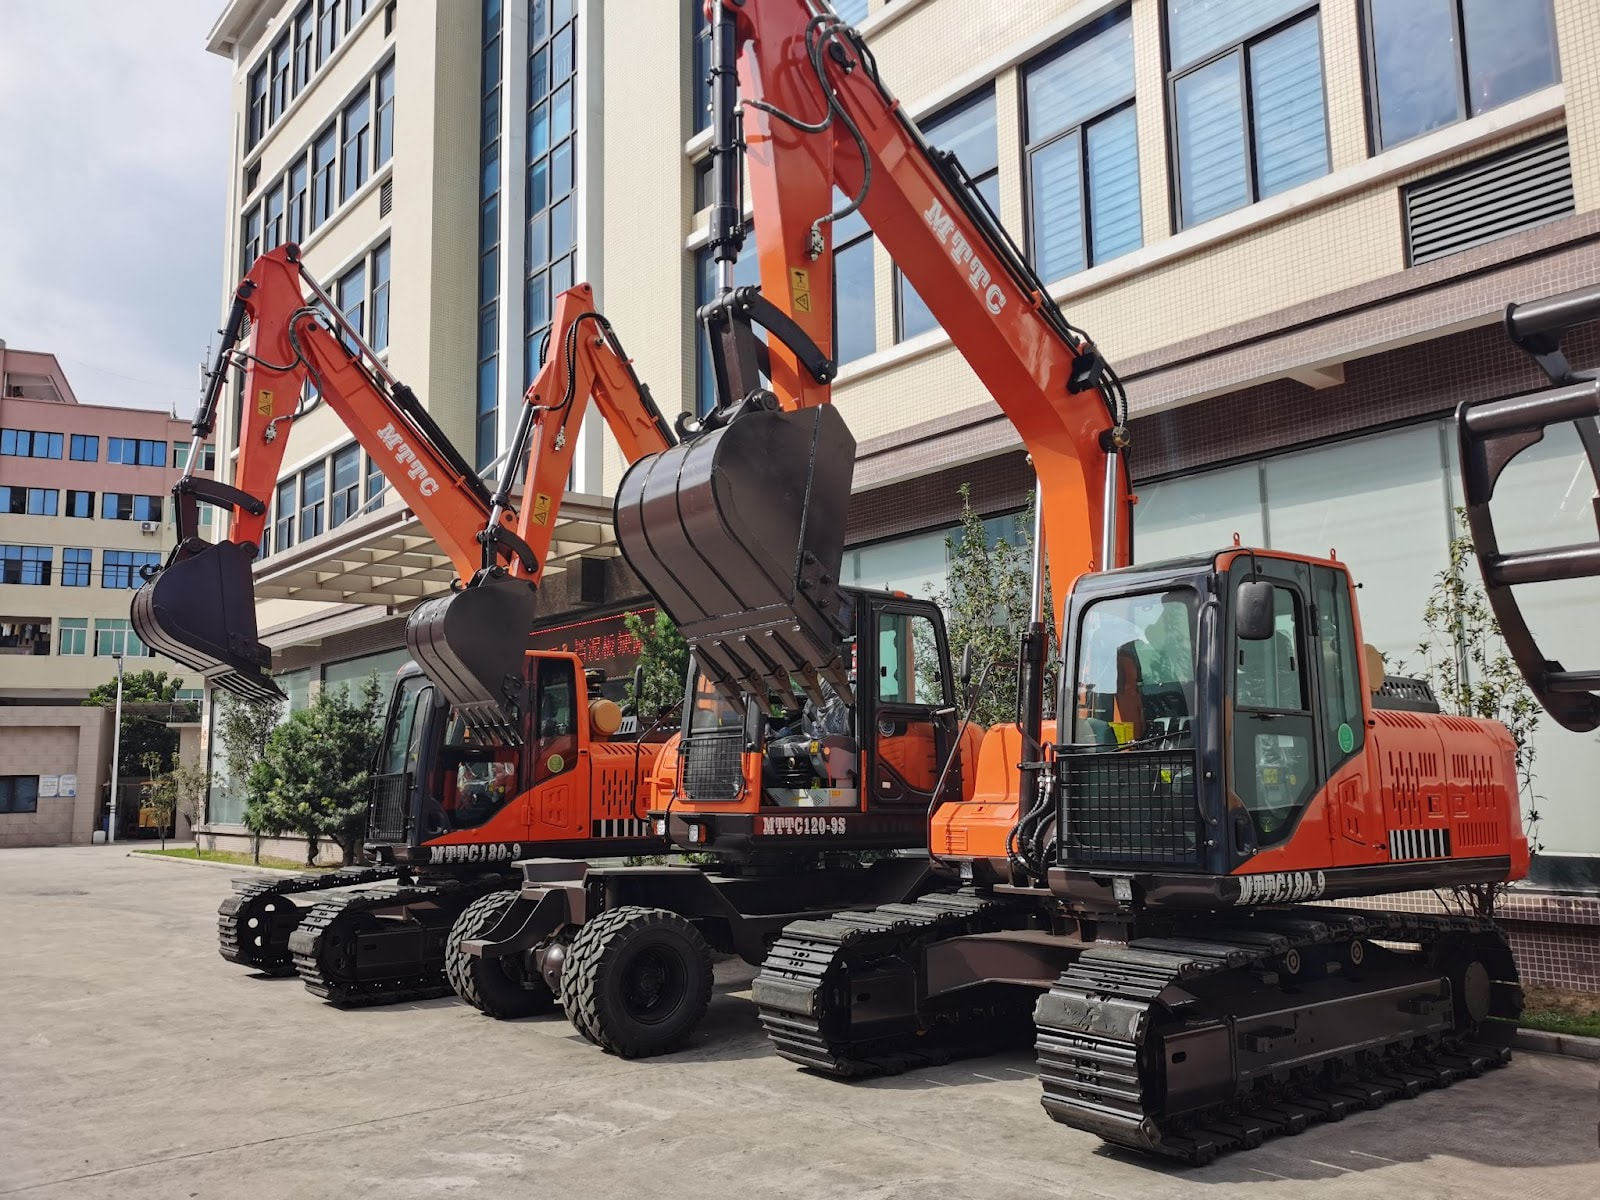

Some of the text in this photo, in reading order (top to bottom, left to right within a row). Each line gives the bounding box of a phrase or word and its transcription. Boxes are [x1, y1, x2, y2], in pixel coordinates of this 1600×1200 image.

[924, 197, 1007, 315] MTTC
[377, 422, 439, 496] MTTC
[763, 816, 846, 835] MTTC120-9S
[429, 843, 521, 863] MTTC180-9
[1235, 870, 1325, 905] MTTC180-9
